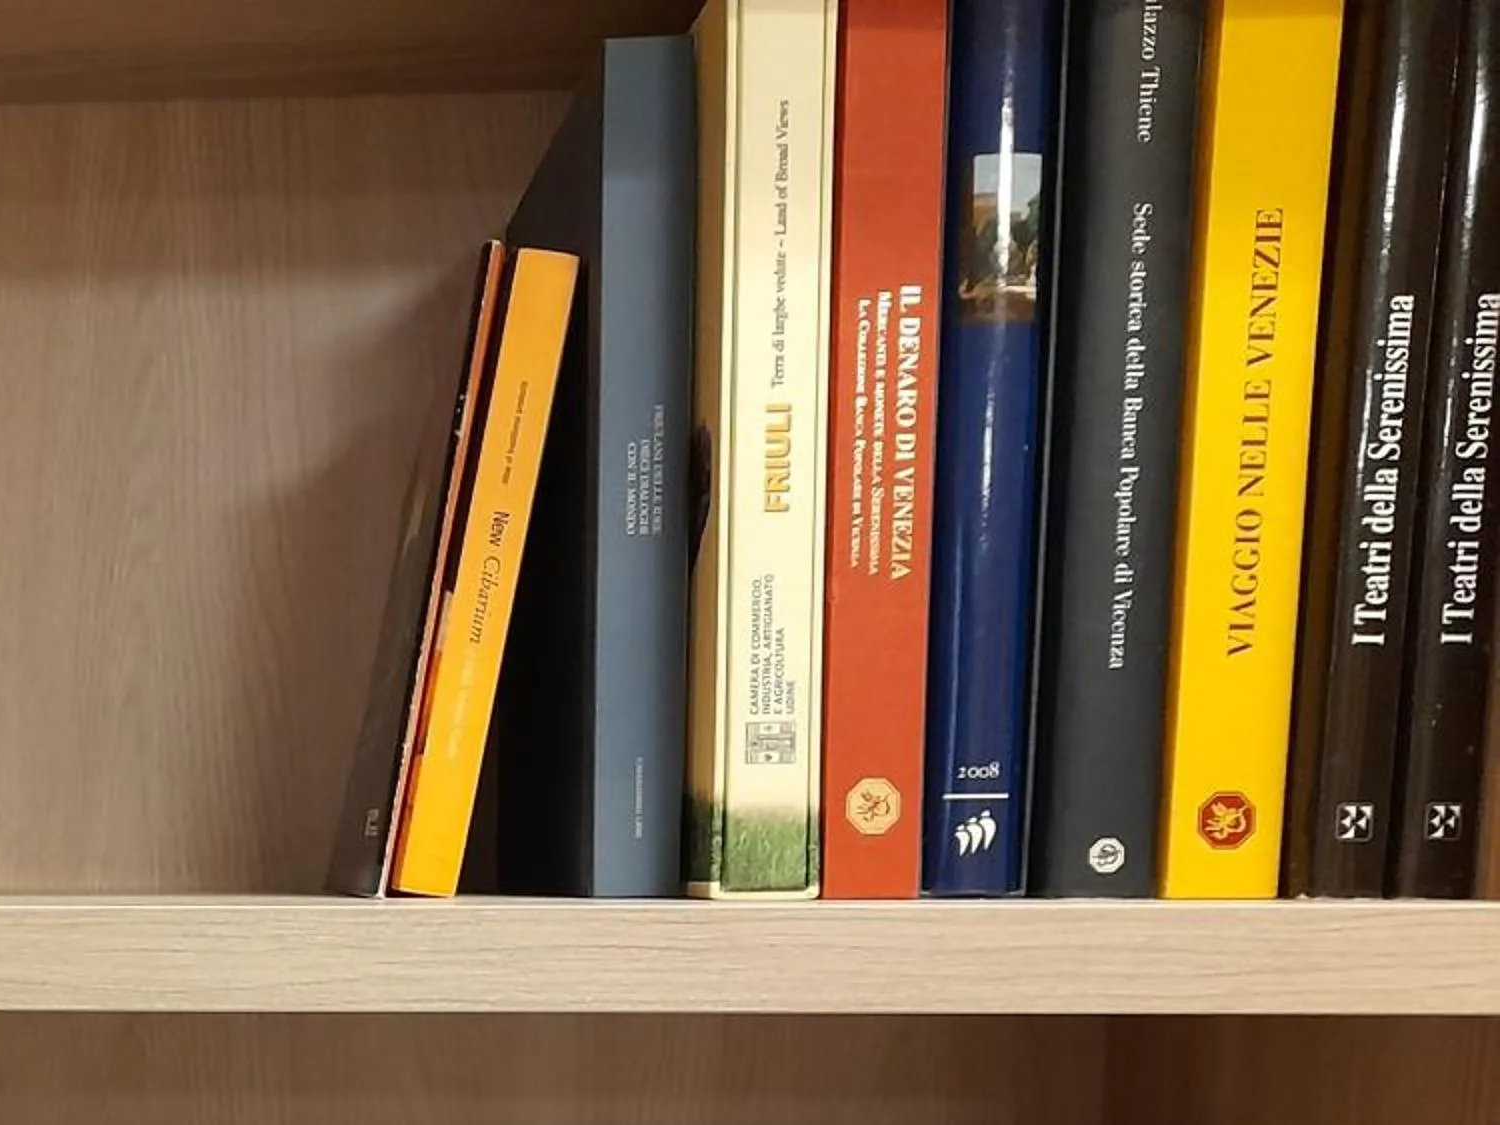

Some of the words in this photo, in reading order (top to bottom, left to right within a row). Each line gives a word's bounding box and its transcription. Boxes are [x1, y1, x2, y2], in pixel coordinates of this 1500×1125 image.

[1141, 0, 1163, 60] lazzo
[776, 100, 790, 140] Views
[1138, 66, 1162, 143] Thiene
[775, 185, 788, 199] of
[776, 144, 789, 182] Broad
[775, 203, 788, 235] Land
[1131, 203, 1153, 254] Sede
[774, 252, 787, 293] vedute
[900, 286, 922, 312] IL
[1126, 260, 1148, 332] storica
[1246, 208, 1283, 367] VENEZIE
[772, 297, 788, 335] larghe
[772, 339, 784, 352] di
[771, 356, 785, 388] Terra
[896, 317, 921, 428] DENARO
[1124, 338, 1146, 390] della
[1368, 294, 1415, 461] Serenissima
[1456, 293, 1500, 459] Serenissima
[764, 404, 791, 512] FRIULI
[895, 434, 916, 460] DI
[1120, 397, 1143, 459] Banca
[1237, 379, 1272, 497] NELLE
[488, 511, 510, 547] New
[891, 466, 915, 579] VENEZIA
[1114, 465, 1141, 557] Popolare
[1362, 468, 1399, 533] della
[1450, 467, 1486, 532] della
[1113, 563, 1134, 583] di
[1227, 509, 1263, 657] VIAGGIO
[1353, 541, 1392, 625] Teatri
[1442, 540, 1480, 624] Teatri
[1108, 589, 1134, 669] Vicenza
[1352, 633, 1385, 647] I
[1441, 632, 1472, 645] I
[957, 762, 1000, 779] 2008
